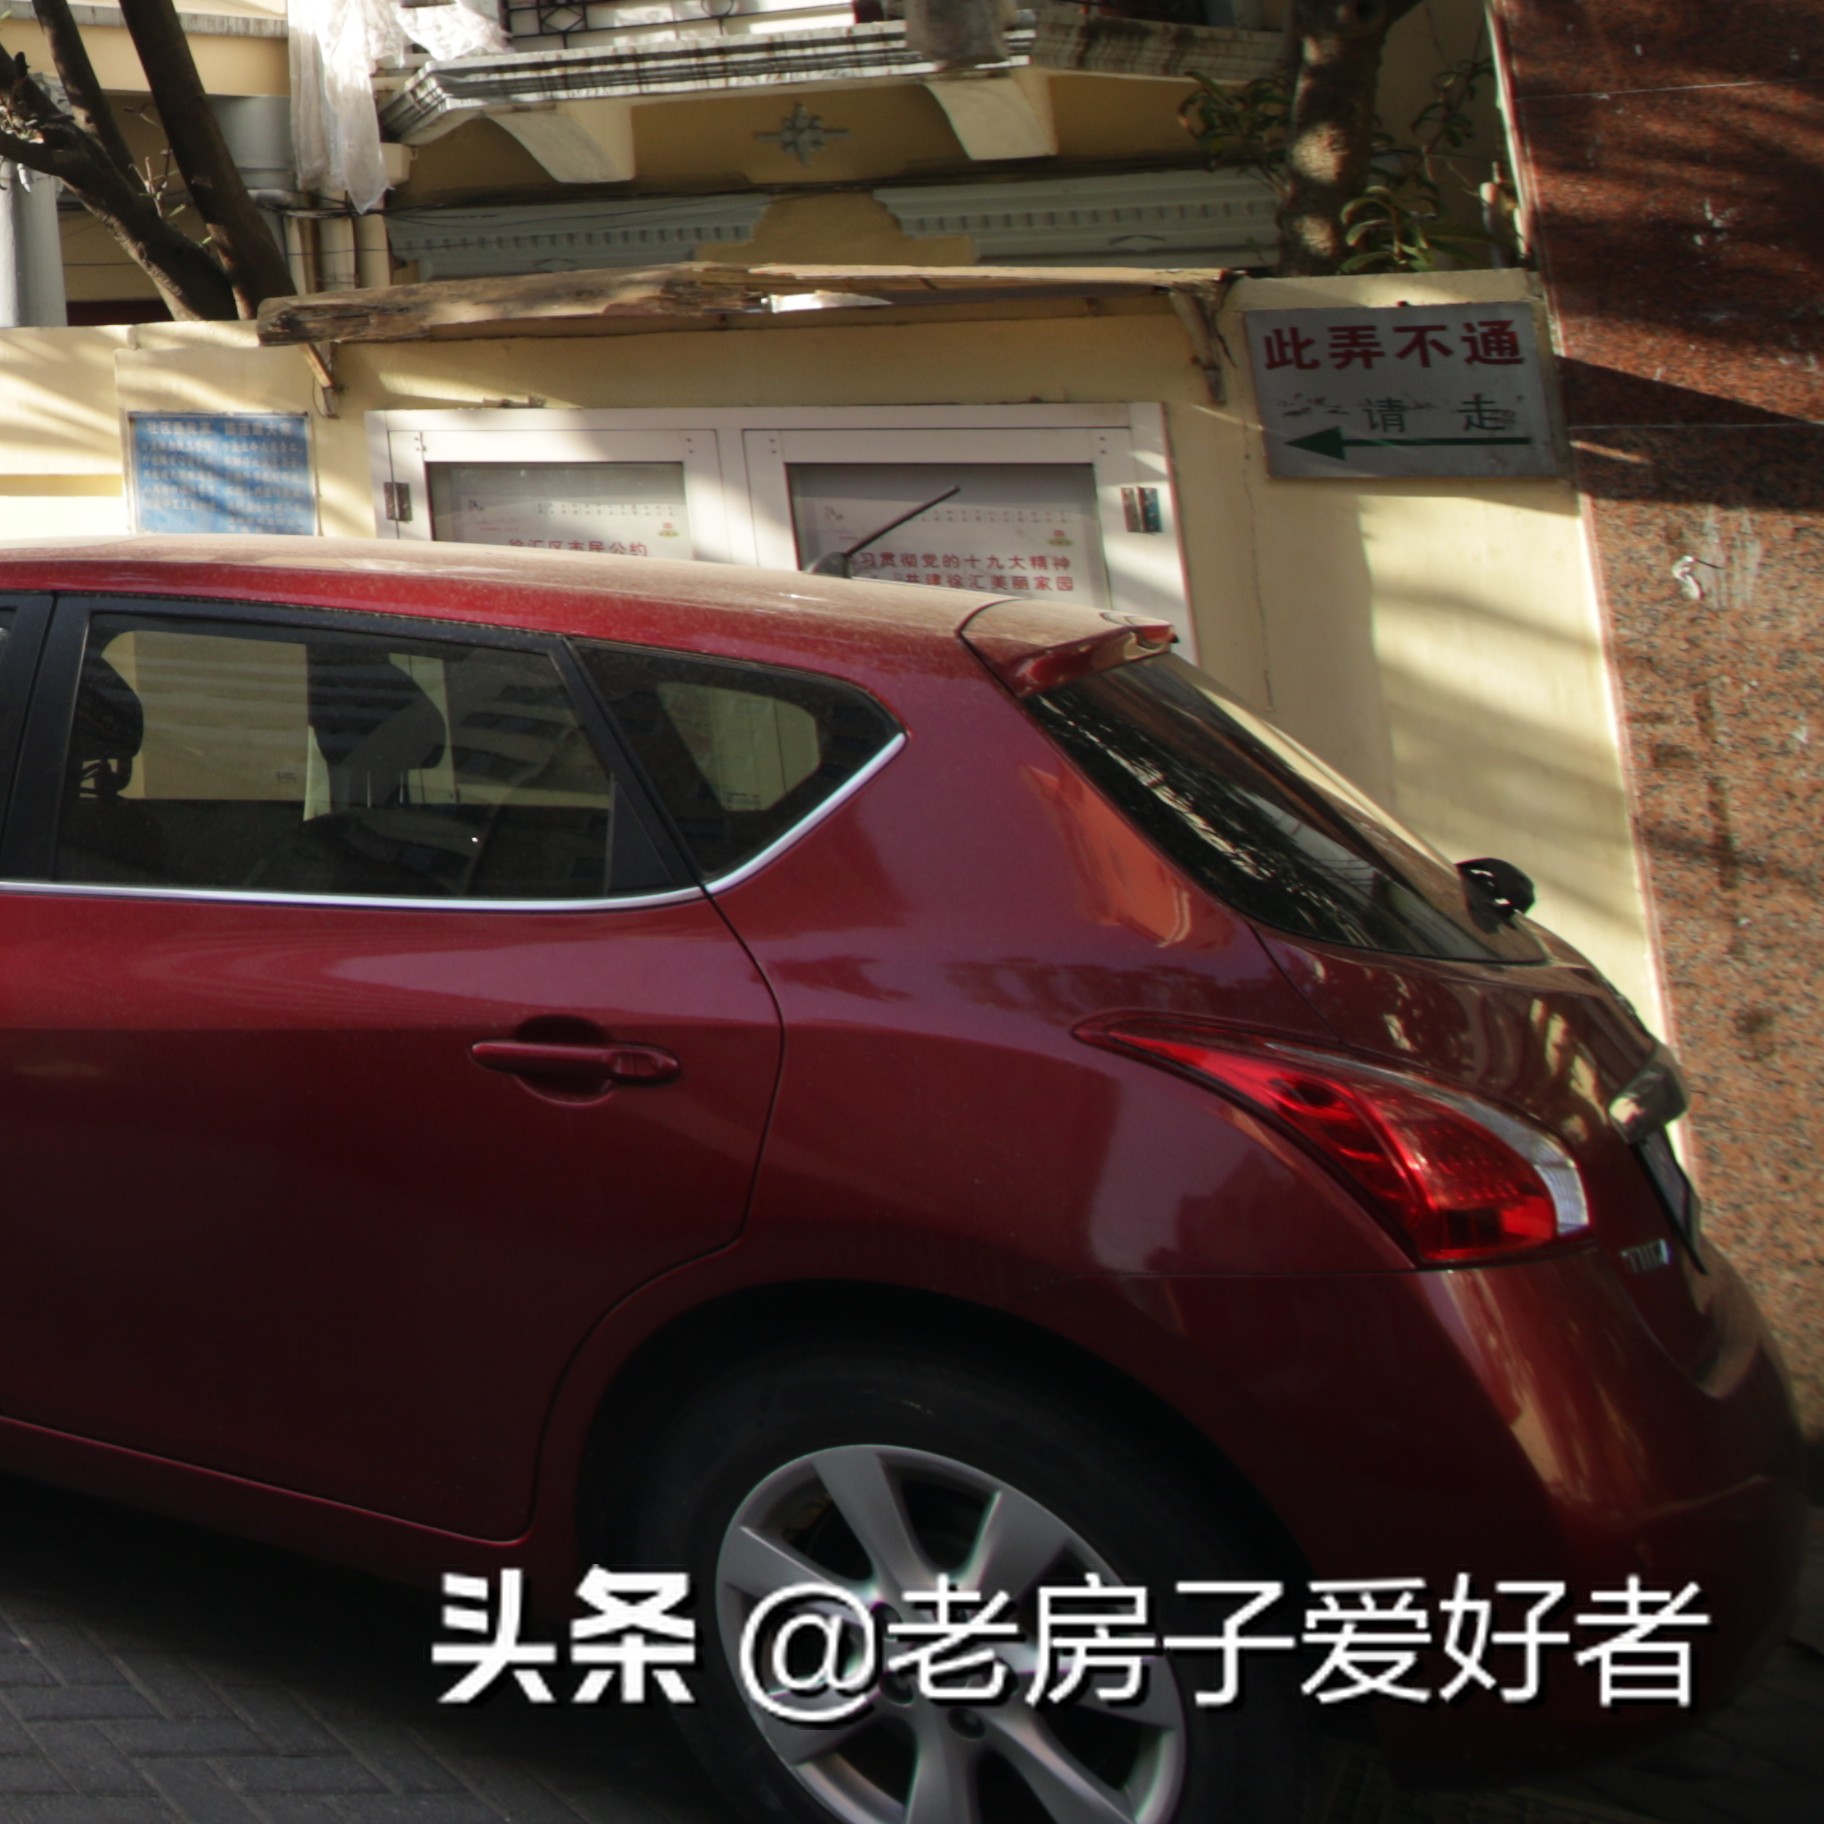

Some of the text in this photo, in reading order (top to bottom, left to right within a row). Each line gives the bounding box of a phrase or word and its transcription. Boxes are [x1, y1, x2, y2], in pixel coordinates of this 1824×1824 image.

[1265, 320, 1524, 370] 此弄不通
[852, 552, 1071, 571] 习贯彻党的十九大精神
